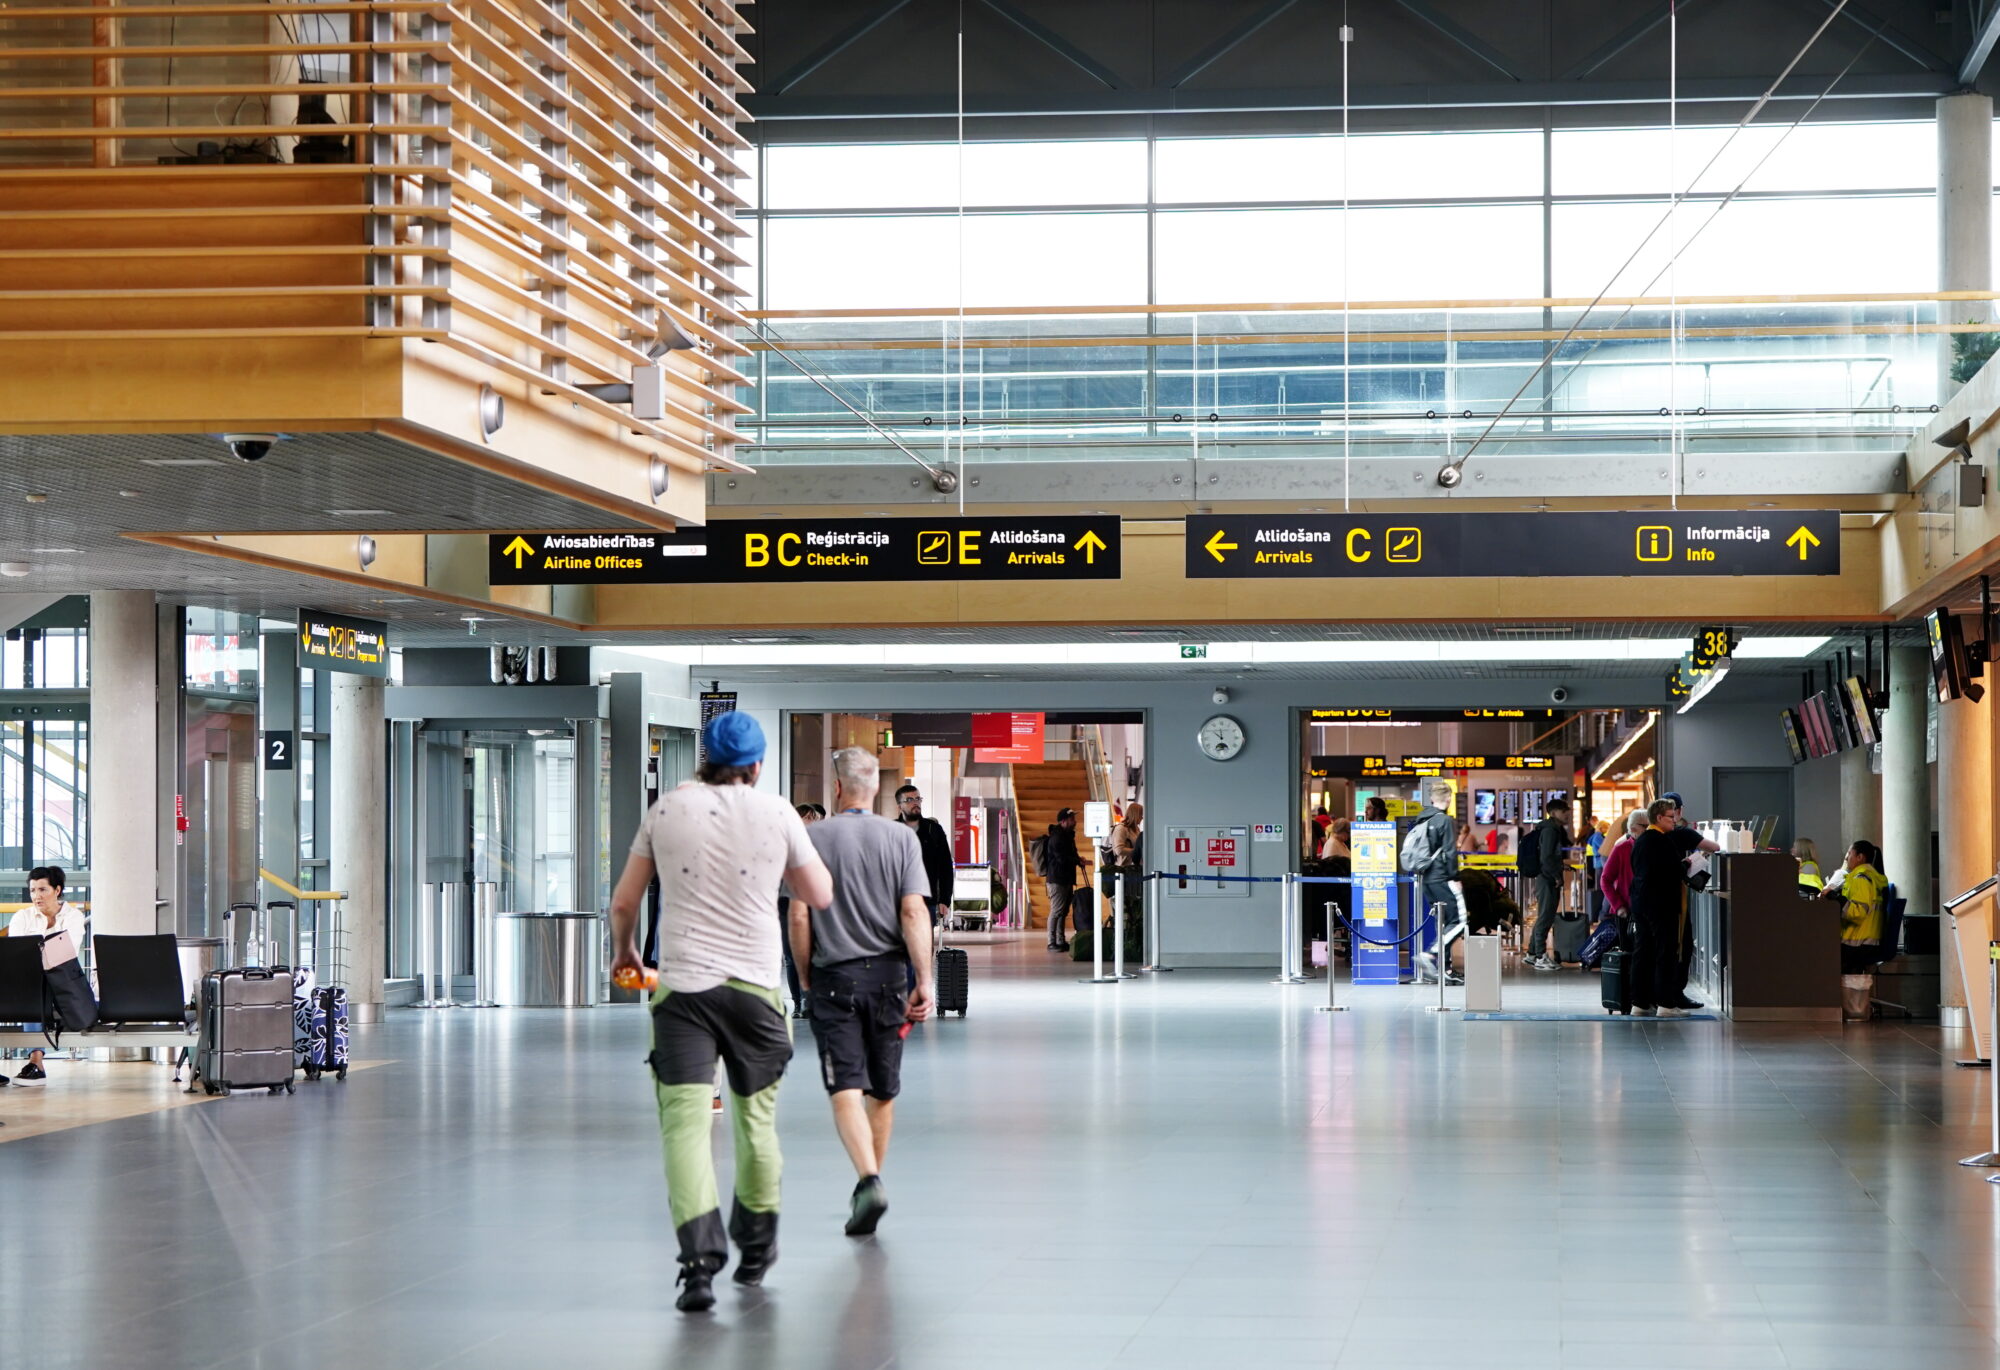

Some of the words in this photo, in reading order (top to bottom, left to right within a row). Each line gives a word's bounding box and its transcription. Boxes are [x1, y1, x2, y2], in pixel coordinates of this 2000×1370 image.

[544, 534, 655, 549] Aviosabiedrības
[806, 531, 890, 547] Reģistrācija
[989, 529, 1066, 544] Atlidošana
[1254, 528, 1331, 543] Atlidošana
[1686, 525, 1771, 543] Informācija
[958, 530, 982, 565] E
[1345, 527, 1372, 563] C
[543, 555, 592, 569] Airline
[594, 555, 643, 569] Offices
[806, 552, 869, 566] Check-in
[1007, 551, 1066, 565] Arrivals
[1254, 549, 1313, 564] Arrivals
[1686, 547, 1716, 562] Info
[1704, 631, 1728, 656] 38
[271, 740, 285, 760] 2
[1223, 841, 1233, 850] 64
